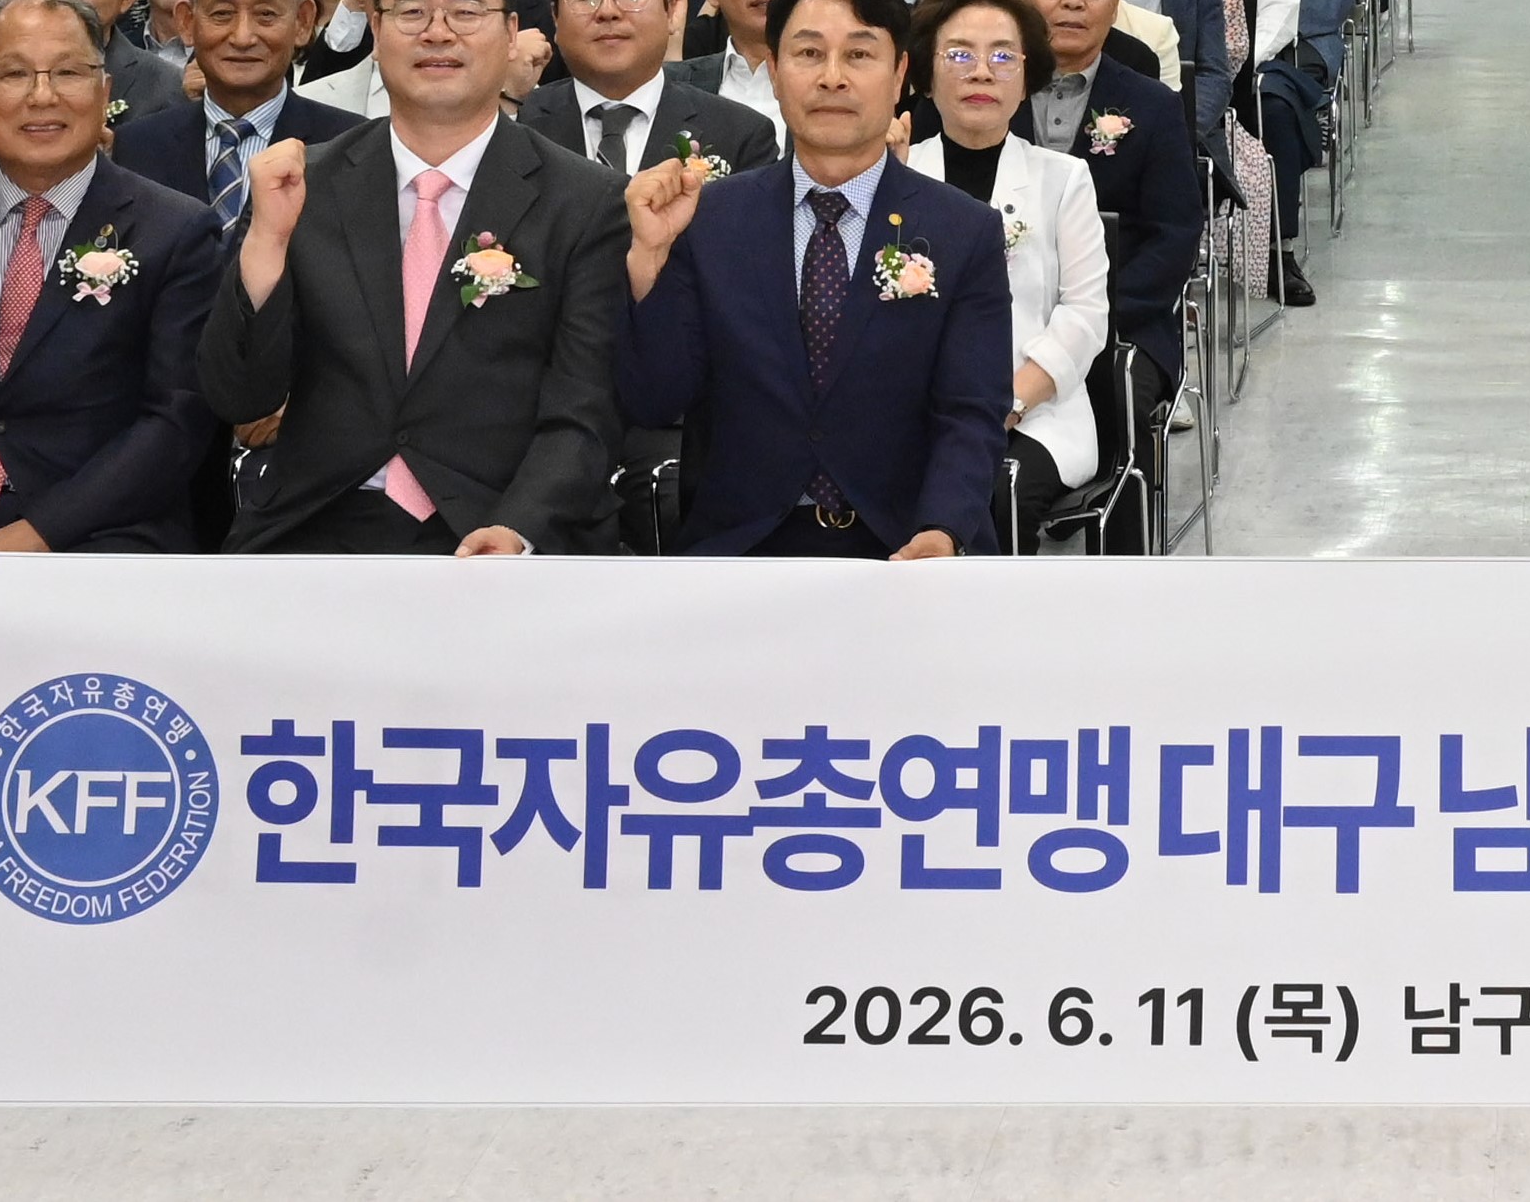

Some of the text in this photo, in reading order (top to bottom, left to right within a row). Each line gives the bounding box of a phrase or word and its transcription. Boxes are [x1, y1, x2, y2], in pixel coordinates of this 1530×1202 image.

[14, 769, 171, 835] KFF
[118, 771, 211, 911] FEDERATION
[241, 719, 1131, 893] 한국자유총연맹
[1159, 726, 1415, 894] 대구
[804, 986, 1023, 1045] 2026.
[1049, 988, 1113, 1045] 6.
[1139, 988, 1204, 1045] 11
[1237, 984, 1359, 1061] (목)
